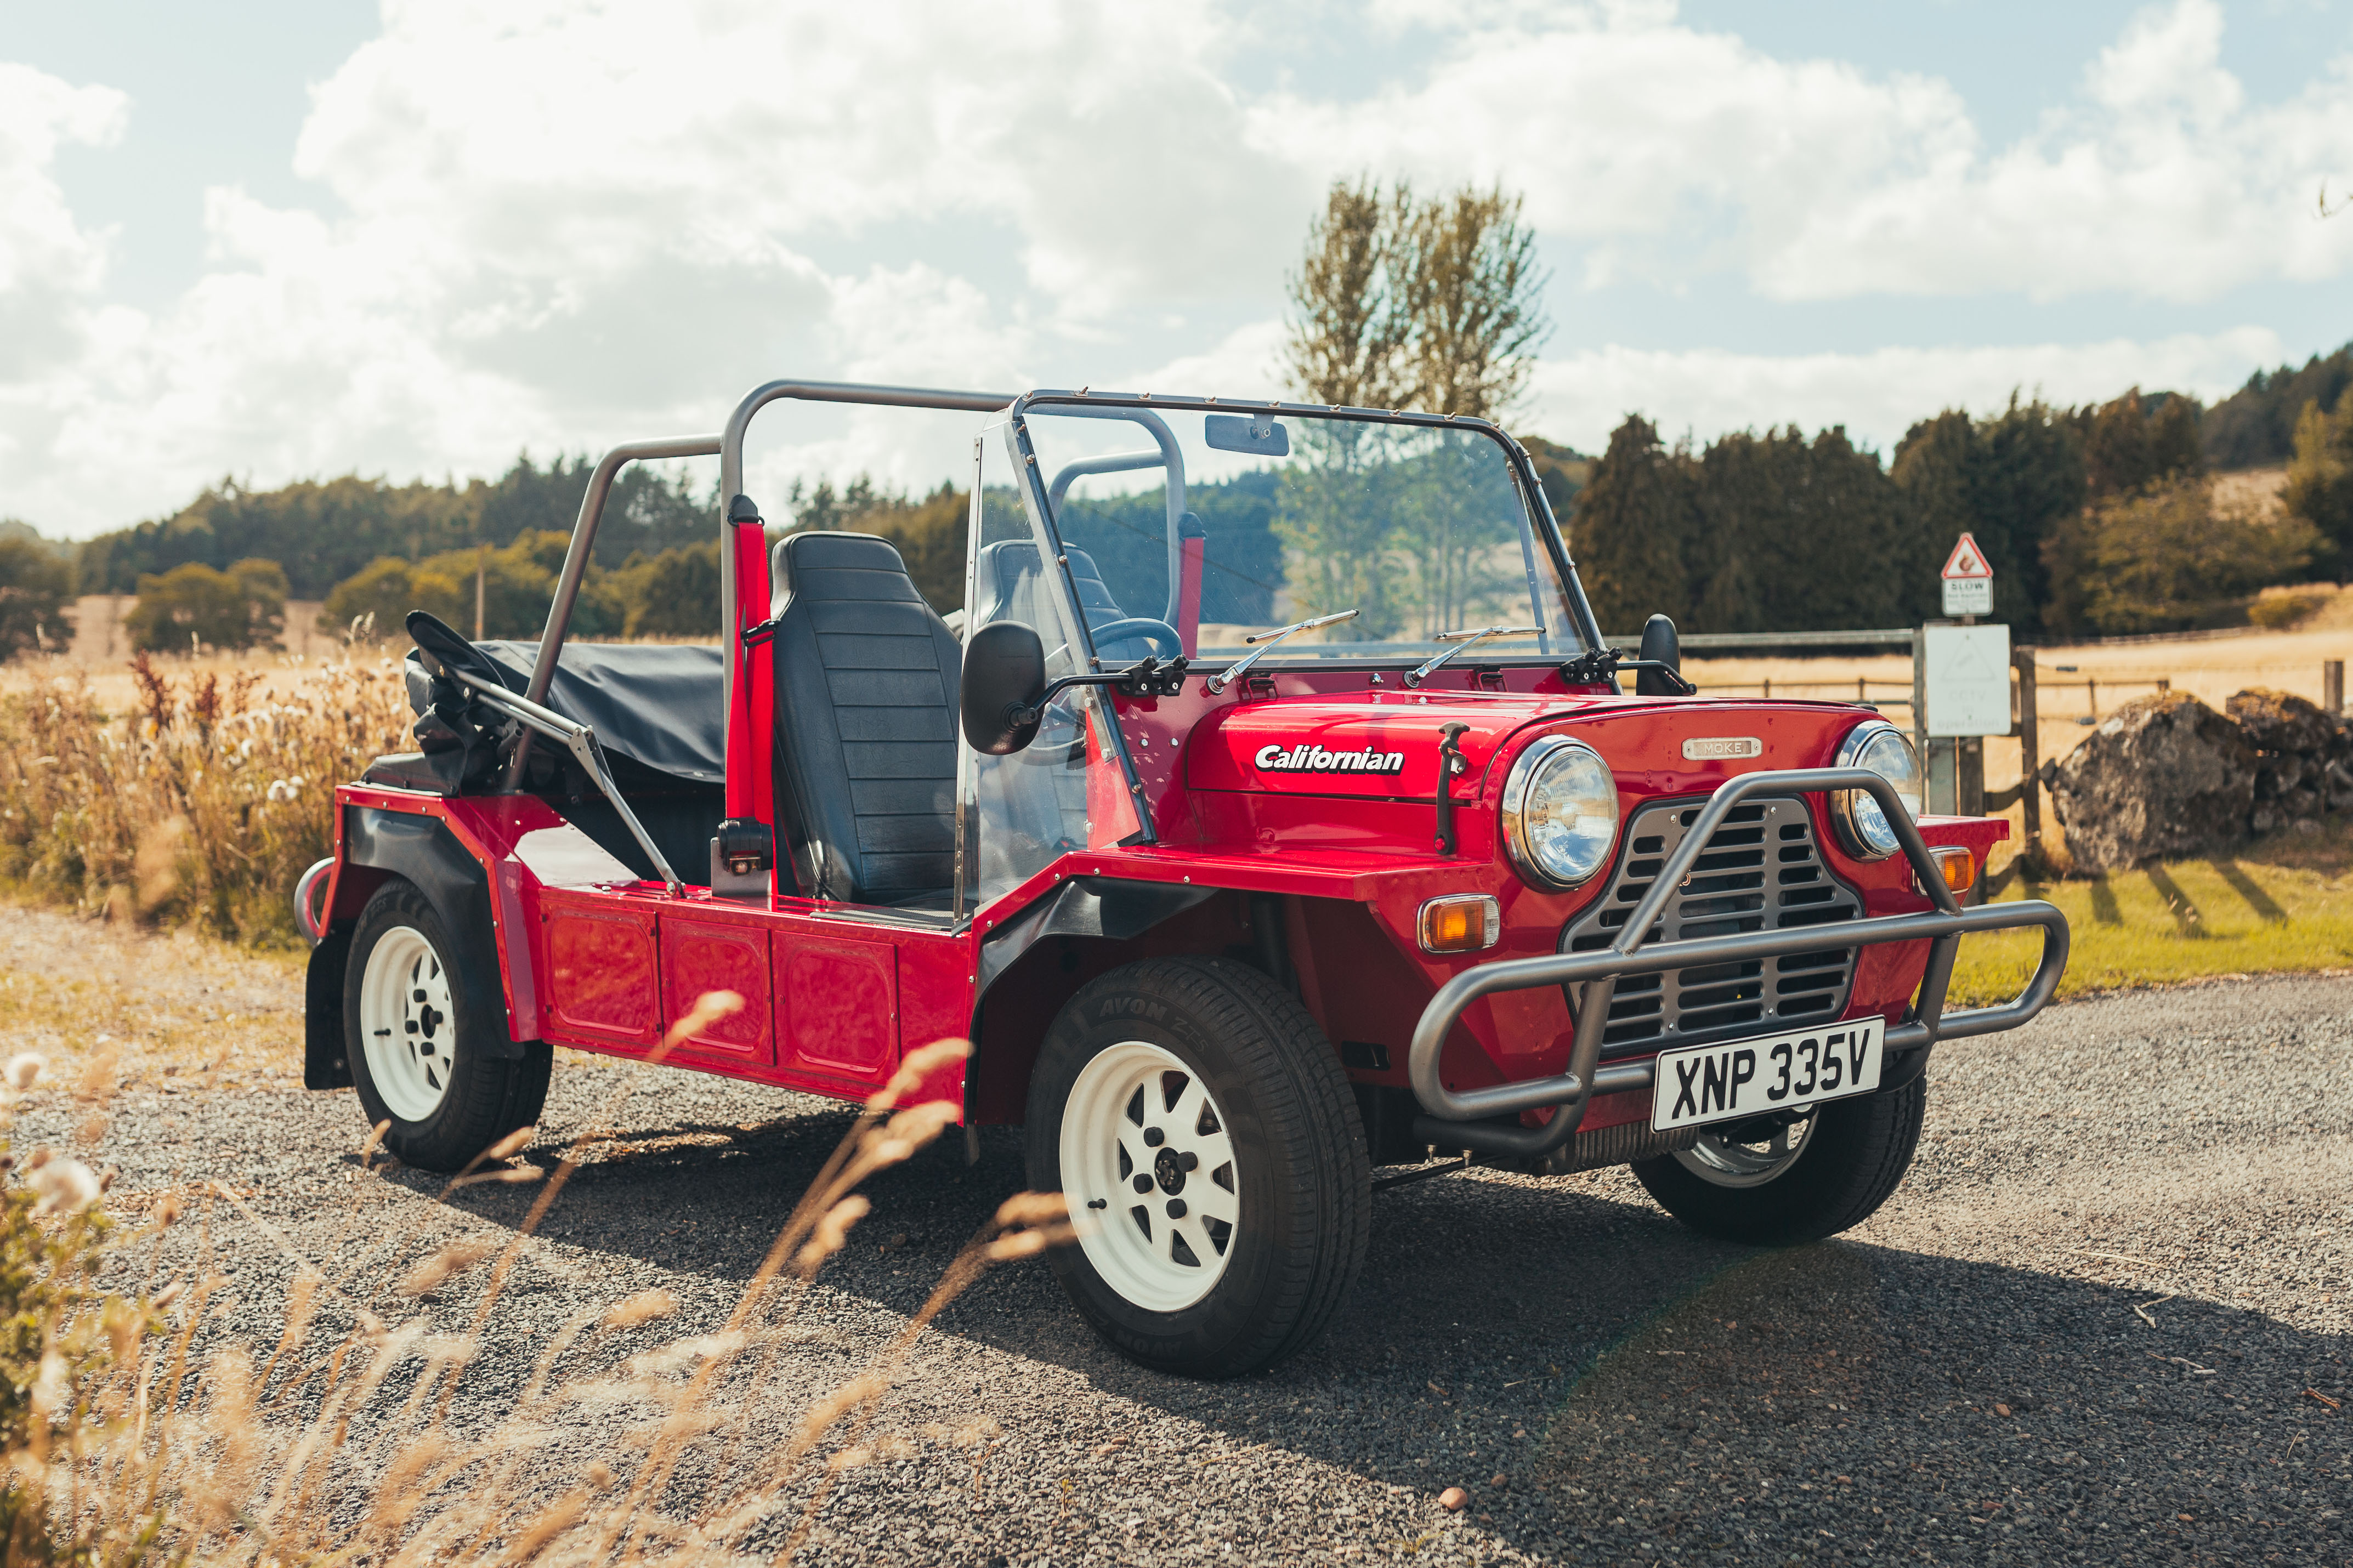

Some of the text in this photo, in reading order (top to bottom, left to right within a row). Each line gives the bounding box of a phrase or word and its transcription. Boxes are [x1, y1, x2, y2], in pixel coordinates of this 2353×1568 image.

[1951, 581, 1984, 591] SLOW
[1948, 690, 1987, 701] CCTV
[1937, 717, 1999, 730] operation
[1704, 742, 1742, 753] MOKE
[1255, 744, 1405, 774] Californian
[1099, 997, 1167, 1021] AVON
[1671, 1029, 1870, 1120] XNP 335V
